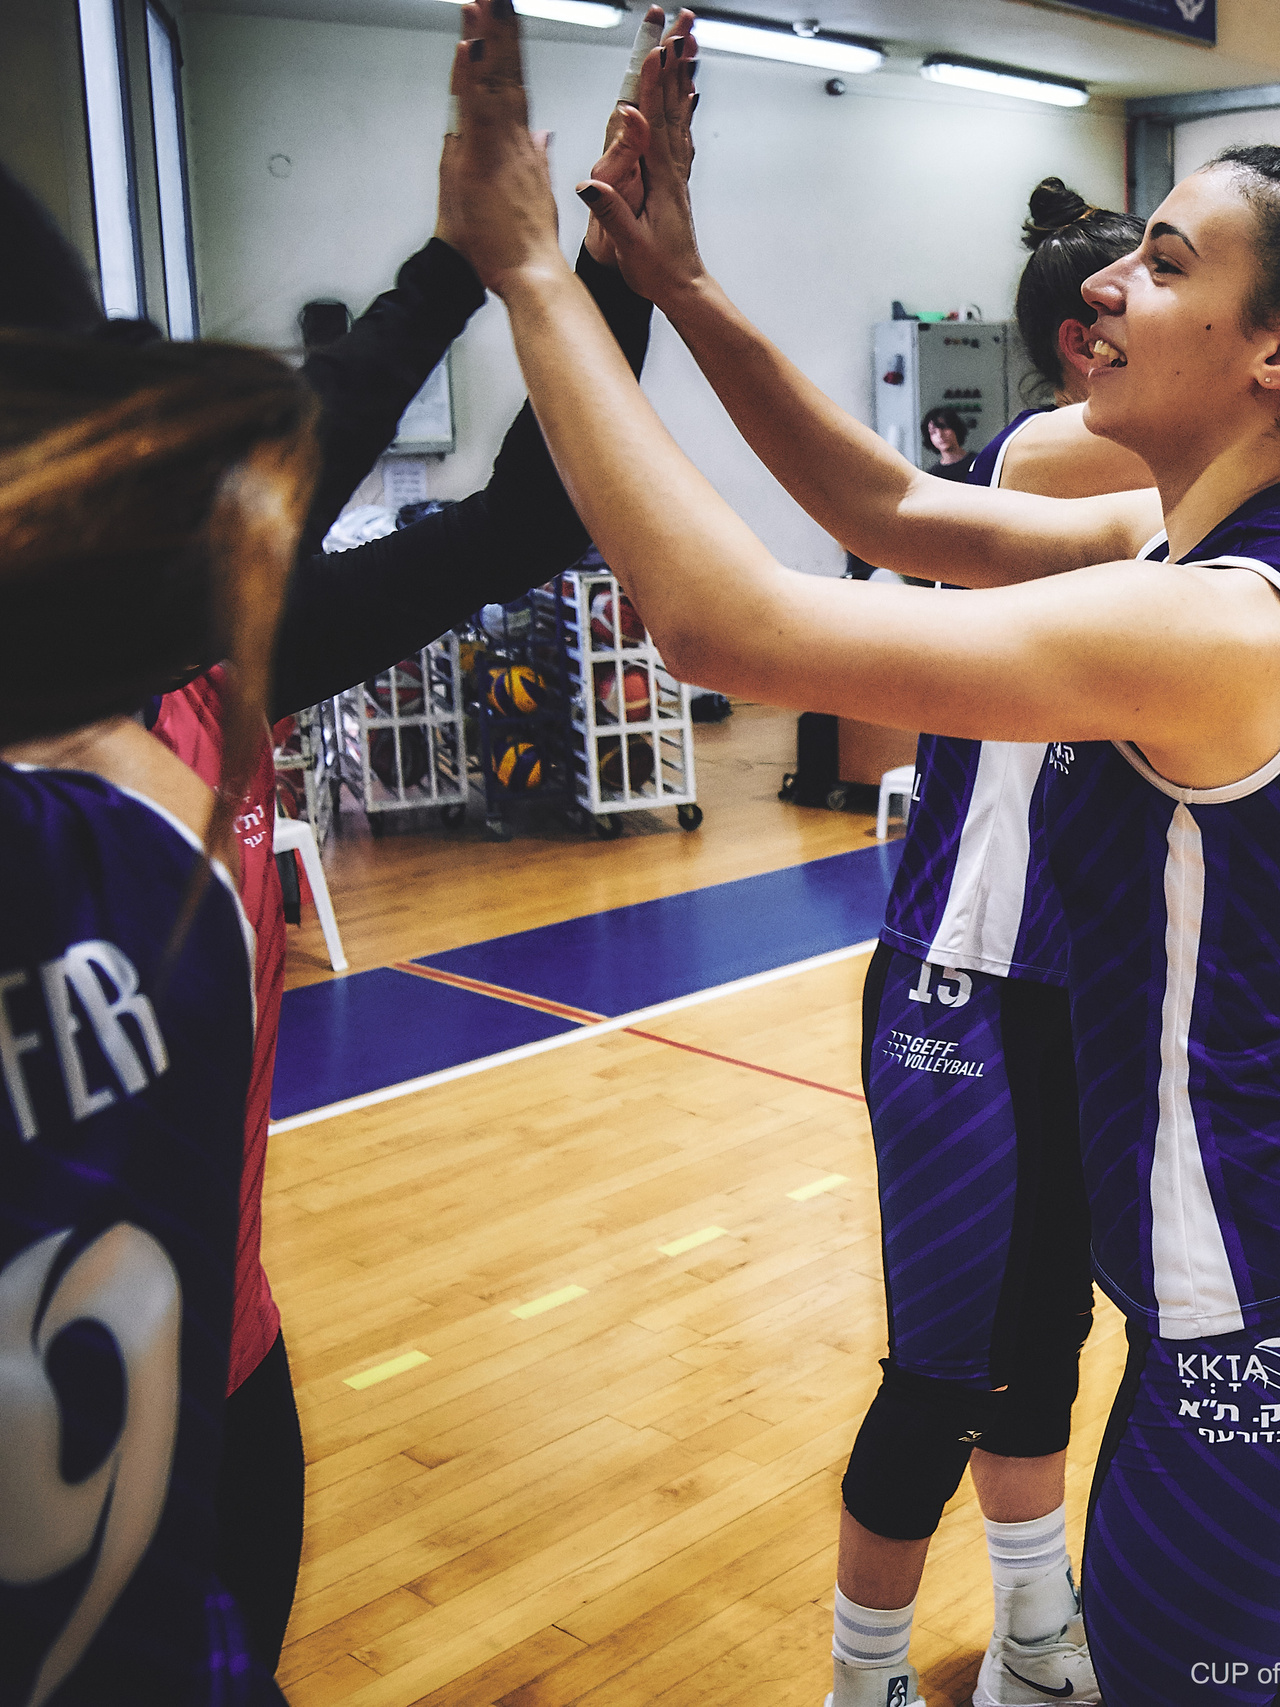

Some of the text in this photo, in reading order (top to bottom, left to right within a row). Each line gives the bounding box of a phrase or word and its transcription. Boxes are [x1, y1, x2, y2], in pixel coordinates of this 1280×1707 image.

[908, 961, 973, 1008] 15
[909, 1037, 959, 1057] GEFF
[904, 1053, 985, 1078] VOLLEYBALL
[1177, 1352, 1269, 1382] KKTA
